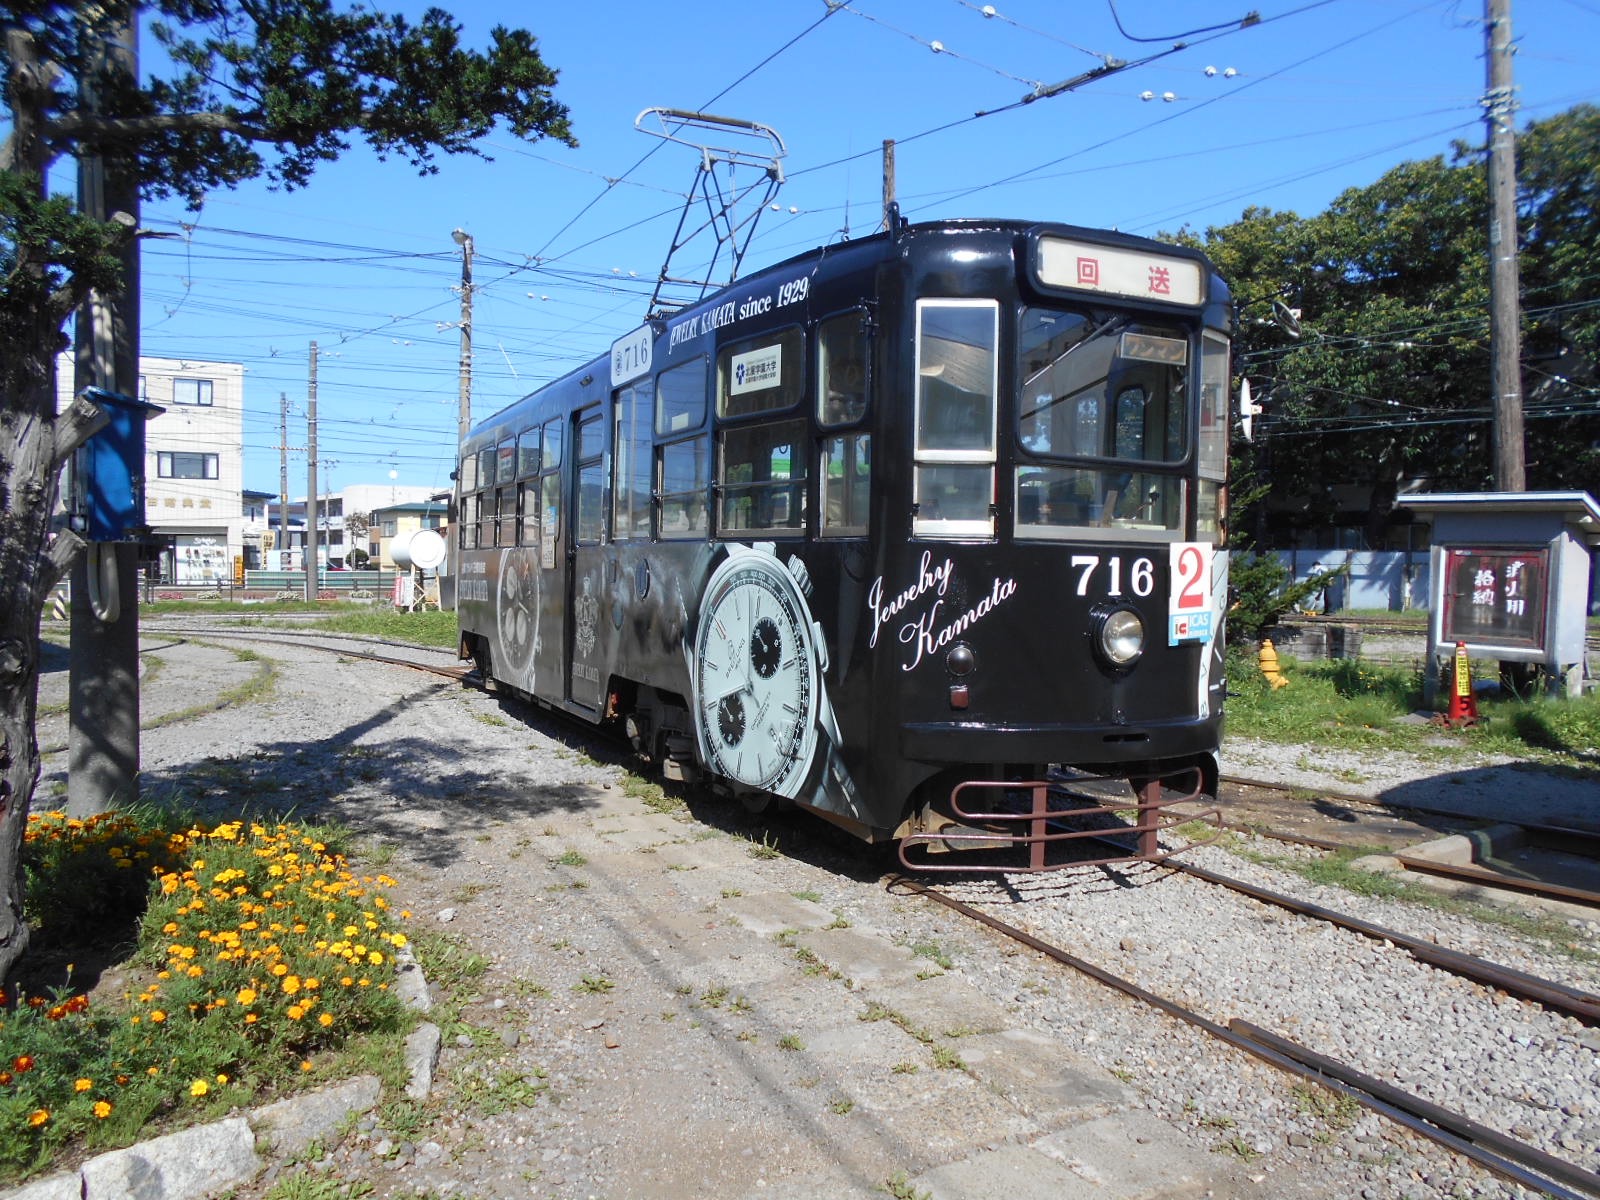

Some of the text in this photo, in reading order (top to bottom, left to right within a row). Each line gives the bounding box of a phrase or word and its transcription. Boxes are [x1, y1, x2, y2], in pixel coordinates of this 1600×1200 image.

[701, 300, 736, 335] KAMATA
[739, 295, 771, 320] since
[776, 276, 808, 308] 1929
[624, 337, 648, 372] 716
[868, 549, 953, 649] Jewelry
[1070, 555, 1154, 597] 716
[1177, 546, 1204, 610] 2
[899, 575, 1017, 671] Kamata
